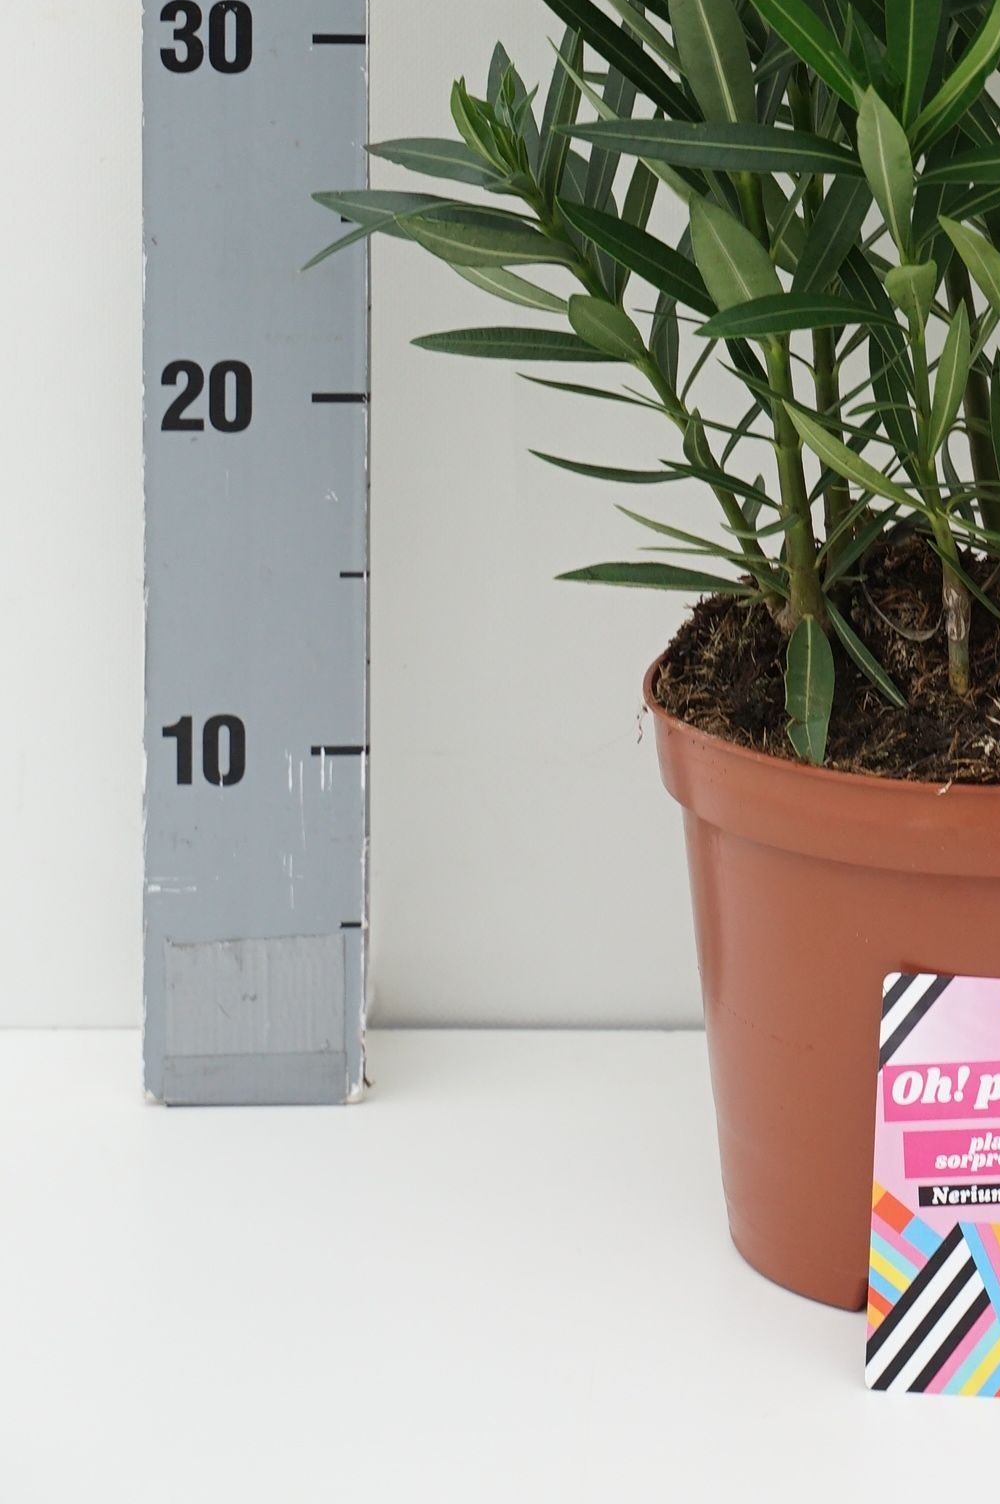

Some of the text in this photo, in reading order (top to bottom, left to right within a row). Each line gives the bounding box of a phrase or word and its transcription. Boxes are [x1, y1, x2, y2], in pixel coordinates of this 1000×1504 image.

[159, 0, 253, 74] 30
[161, 360, 253, 433] 20
[162, 714, 246, 786] 10
[892, 1064, 969, 1106] Oh!
